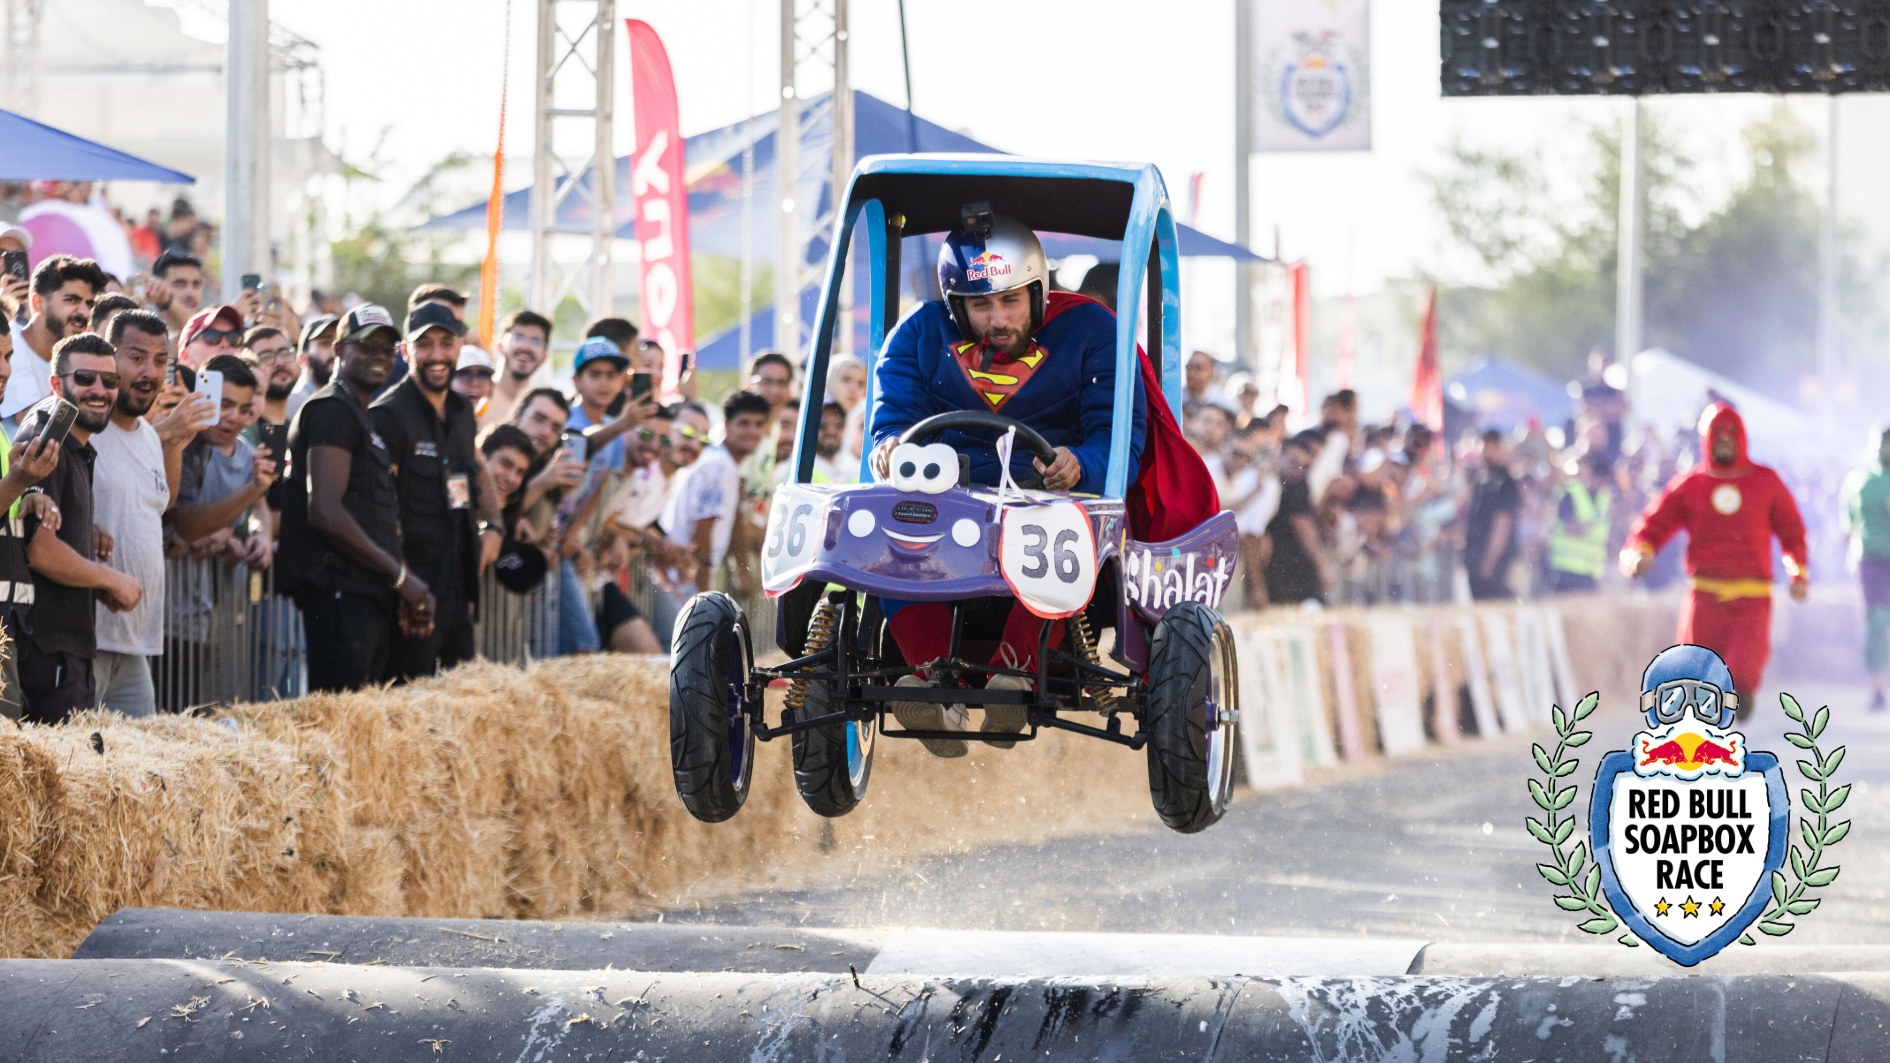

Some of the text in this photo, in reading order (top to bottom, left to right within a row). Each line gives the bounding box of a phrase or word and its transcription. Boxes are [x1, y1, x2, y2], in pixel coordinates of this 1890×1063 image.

[967, 264, 1012, 281] Red Bull
[767, 503, 814, 558] 36
[1021, 524, 1080, 584] 36
